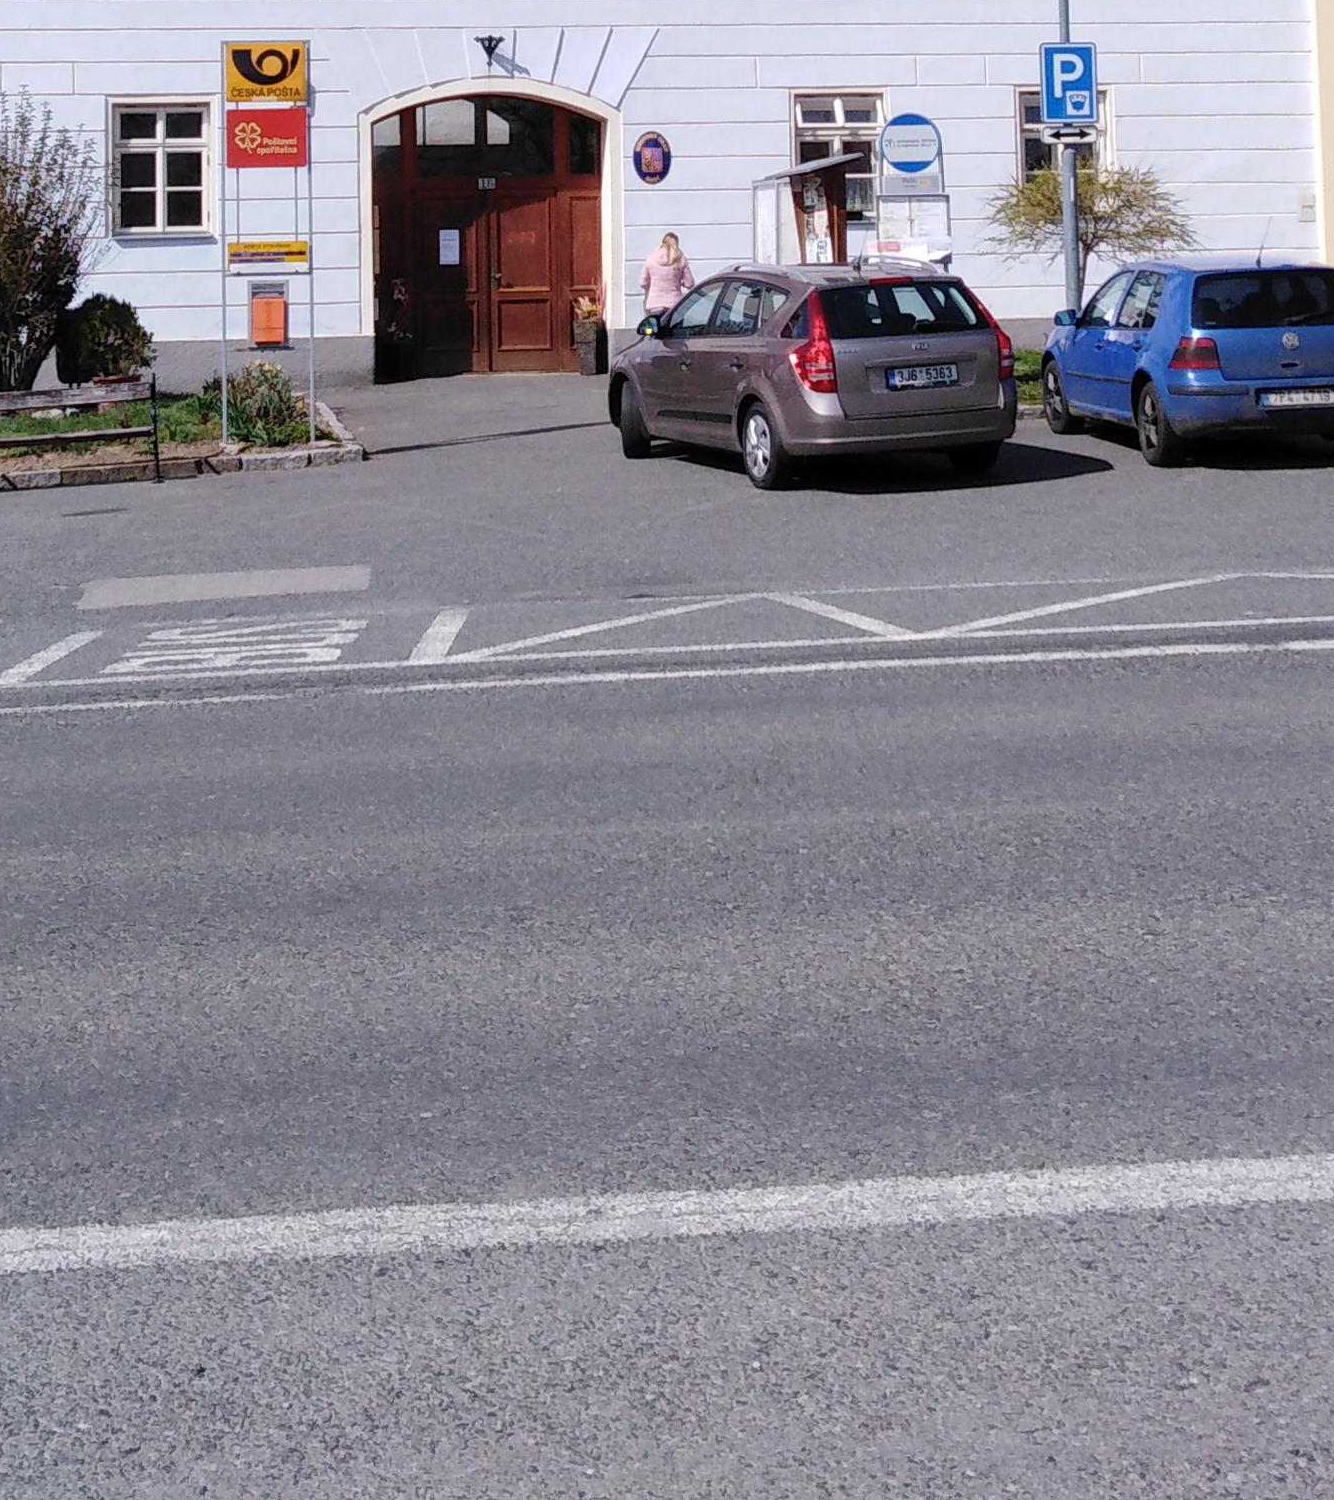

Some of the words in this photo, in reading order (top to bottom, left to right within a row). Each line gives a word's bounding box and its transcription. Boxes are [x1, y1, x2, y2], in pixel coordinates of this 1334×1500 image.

[1053, 53, 1084, 98] P
[230, 86, 266, 98] ČESKÁ
[267, 86, 301, 98] POŠTA
[897, 369, 918, 383] 3J6
[925, 366, 953, 381] 5363
